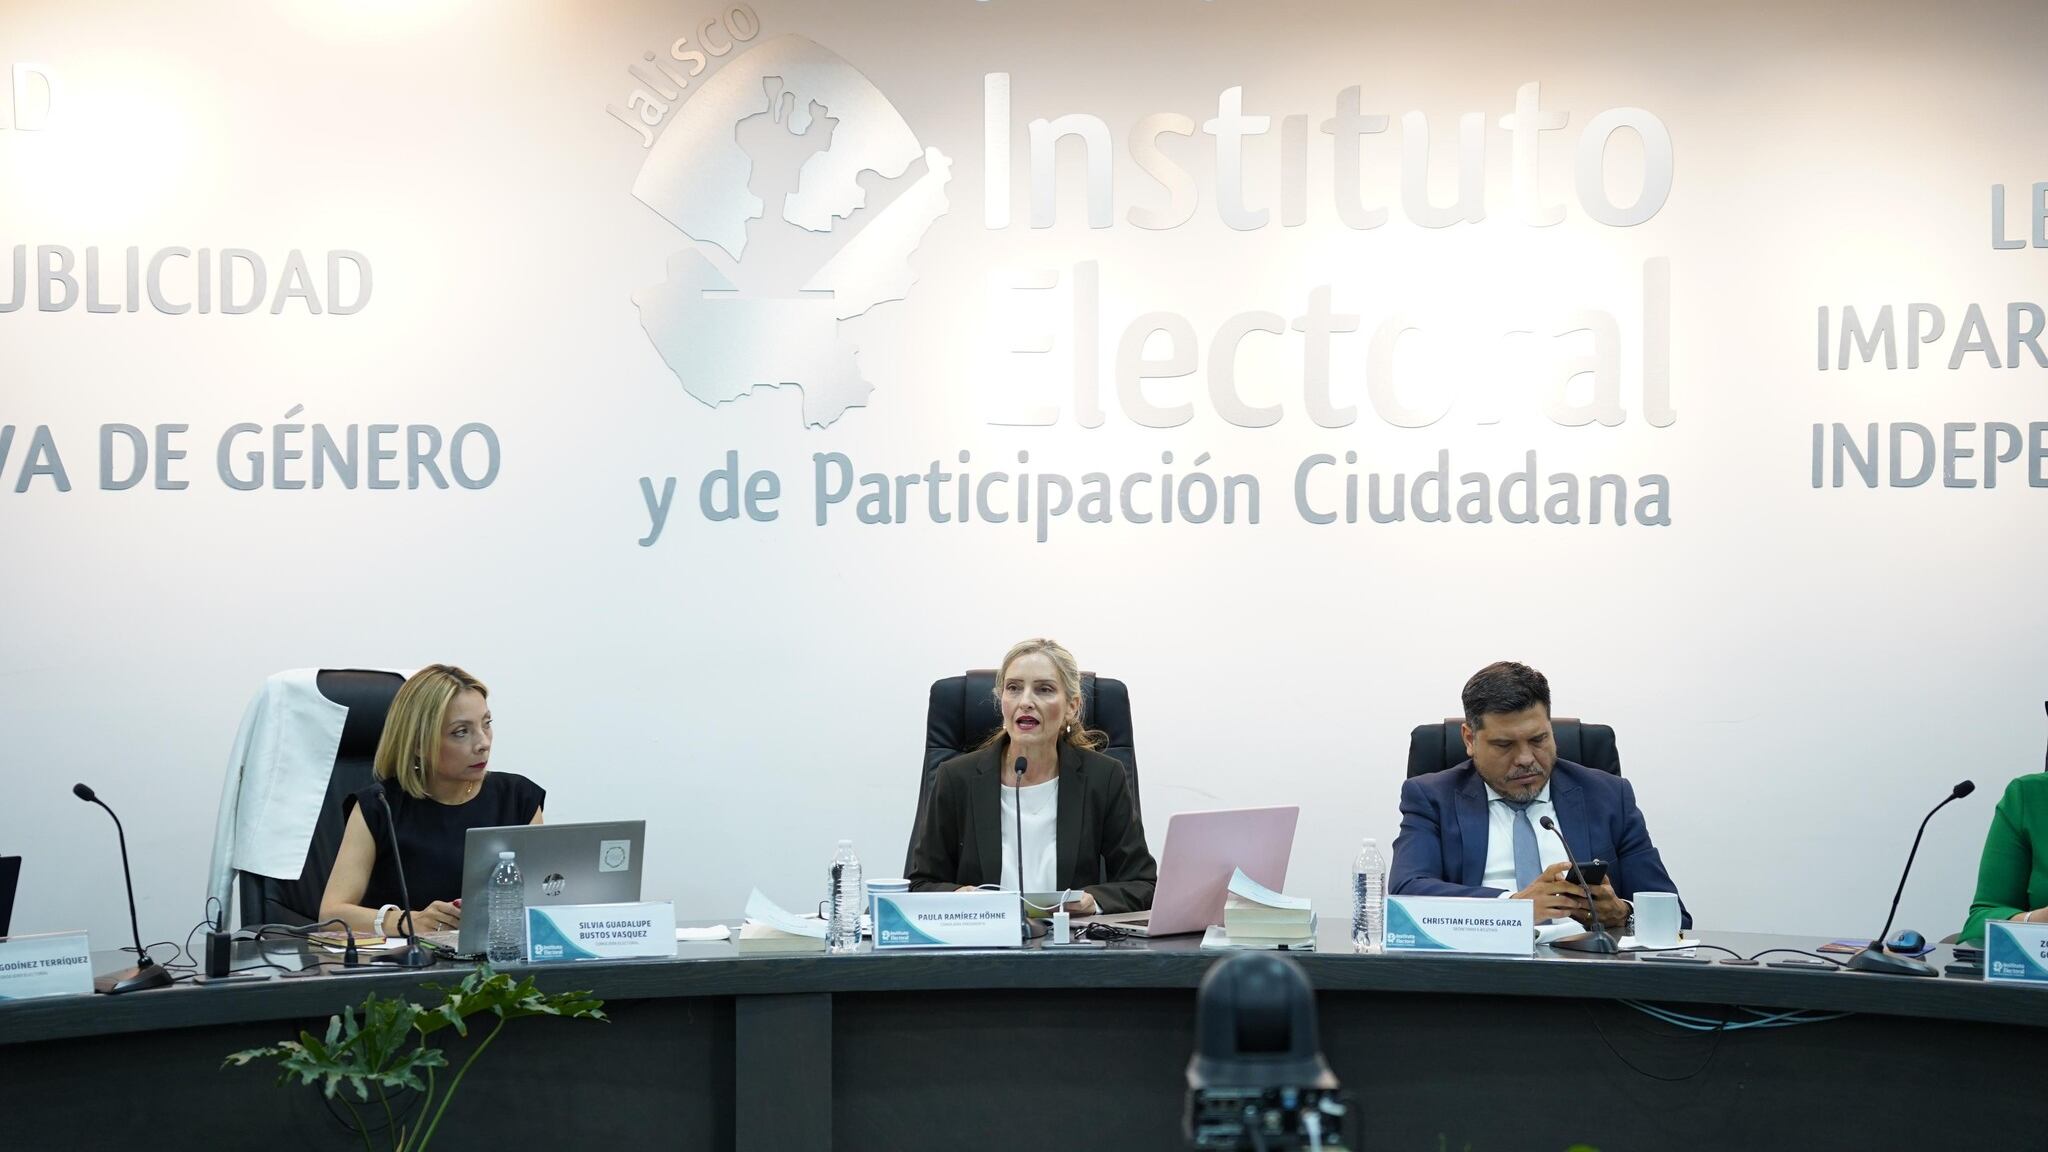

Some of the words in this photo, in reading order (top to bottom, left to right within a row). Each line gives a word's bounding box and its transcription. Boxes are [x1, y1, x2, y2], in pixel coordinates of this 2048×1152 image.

[605, 3, 760, 149] Jalisco
[984, 71, 1675, 231] Instituto
[99, 422, 190, 491] DE
[216, 403, 501, 491] GÉNERO
[638, 476, 677, 547] y
[700, 450, 781, 522] de
[812, 450, 1260, 543] Participación
[1293, 448, 1672, 528] Ciudadana
[918, 913, 943, 921] PAULA
[944, 911, 978, 921] RAMÍREZ
[579, 921, 604, 929] SILVIA
[606, 920, 651, 929] GUADALUPE
[1422, 917, 1464, 926] CHRISTIAN
[1465, 918, 1495, 927] FLORES
[1496, 919, 1522, 928] GARZA
[580, 931, 610, 940] BUSTOS
[612, 930, 648, 939] VASQUEZ
[40, 956, 88, 967] TERRÍQUEZ
